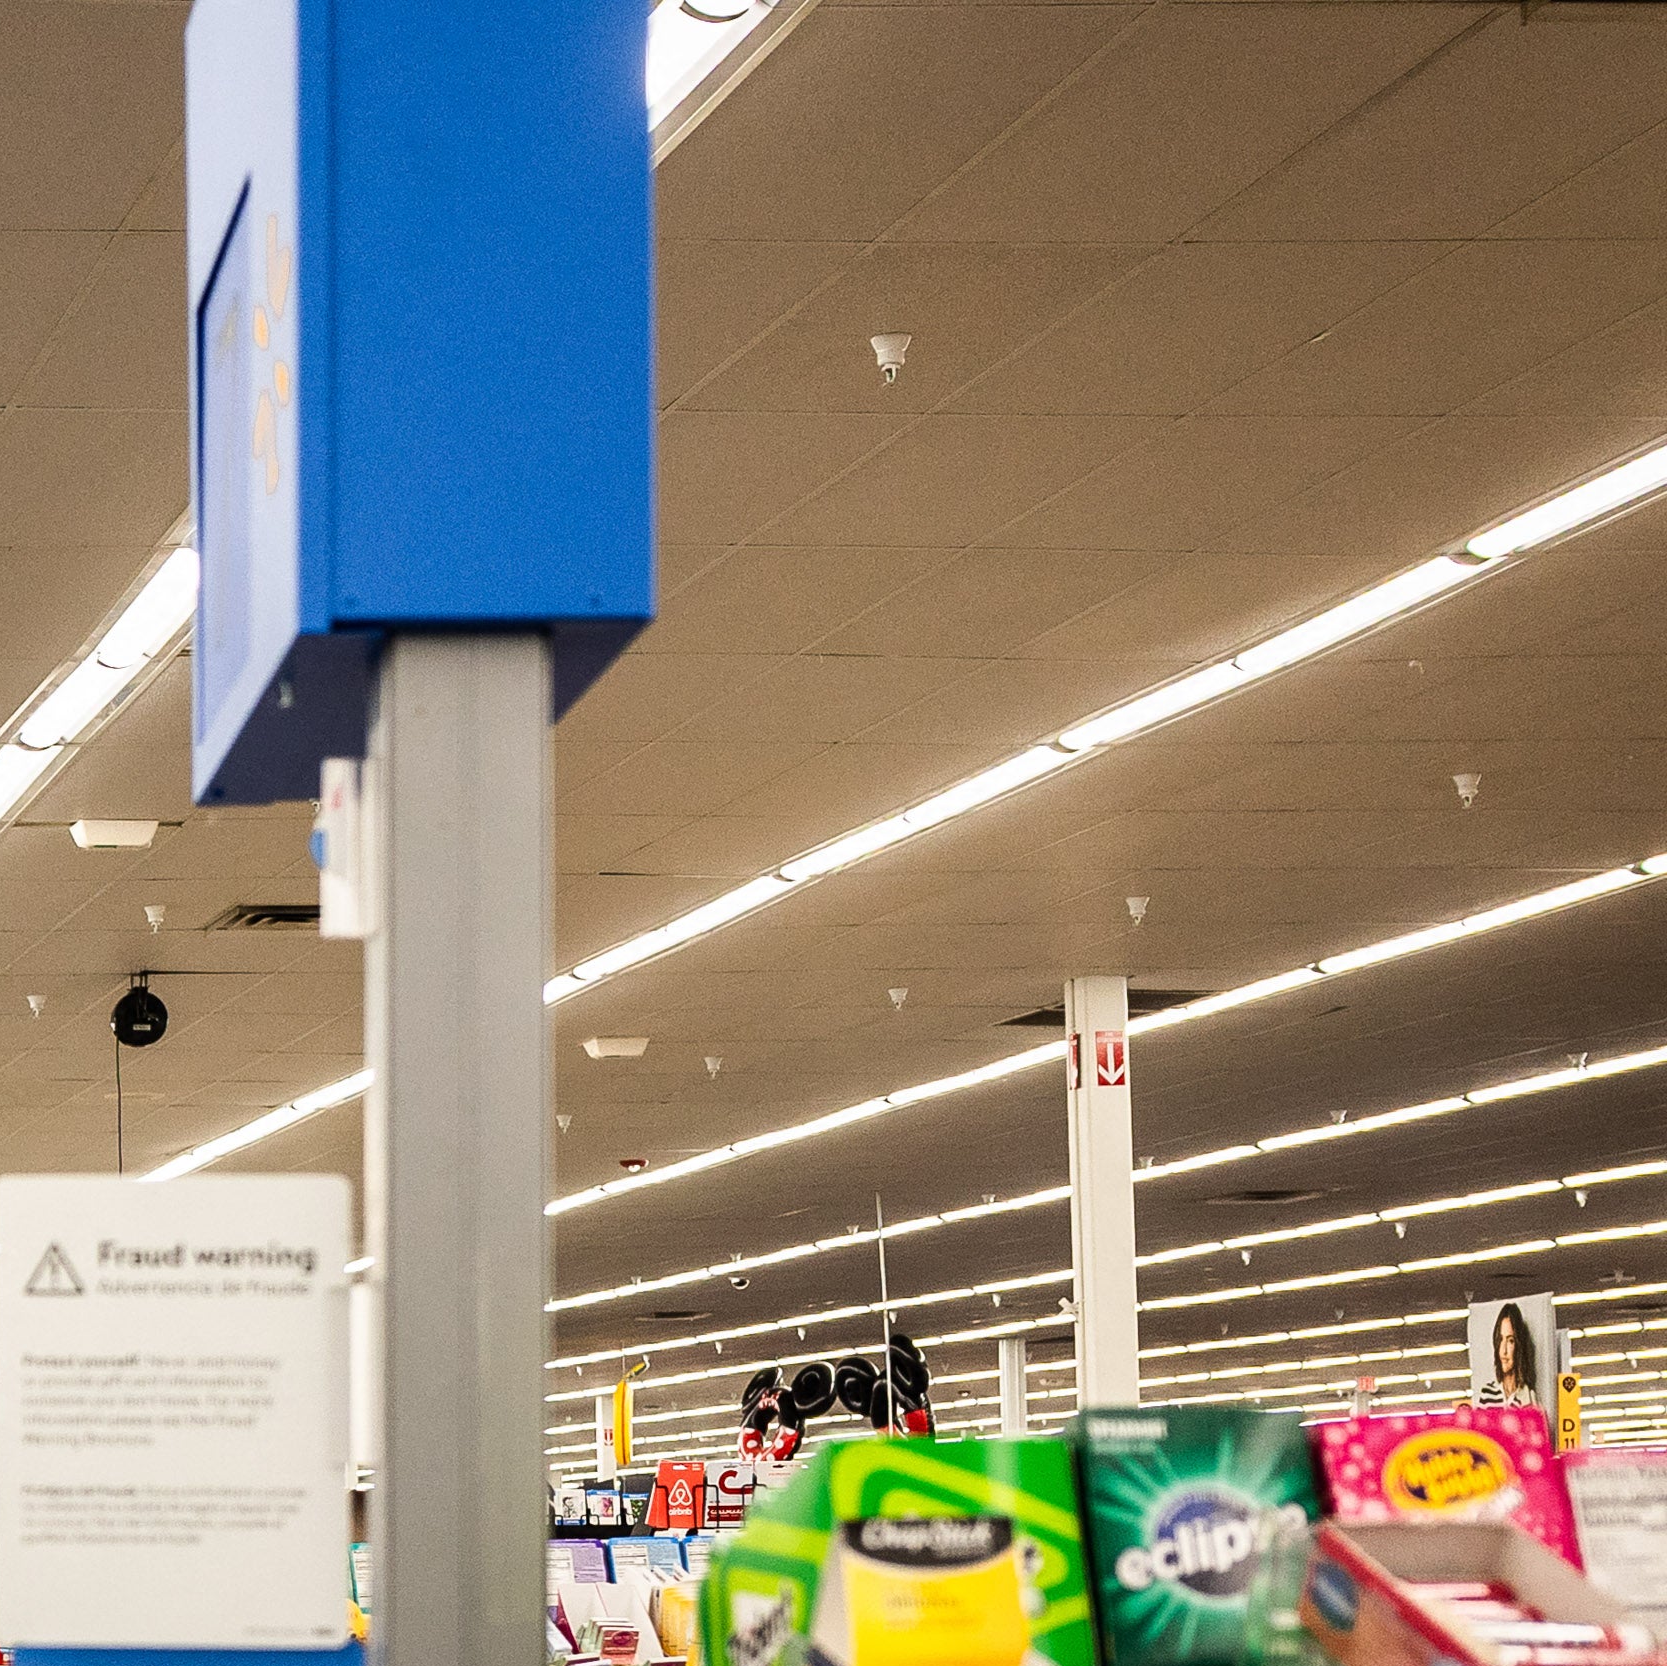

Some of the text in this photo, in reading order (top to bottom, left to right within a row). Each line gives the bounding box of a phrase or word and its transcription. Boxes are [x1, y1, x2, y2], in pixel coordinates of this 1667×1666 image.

[96, 1239, 319, 1275] Fraud warning
[1563, 1419, 1575, 1432] D
[1564, 1437, 1575, 1449] 11
[669, 1507, 693, 1516] airbnb
[861, 1519, 994, 1549] ChapStick
